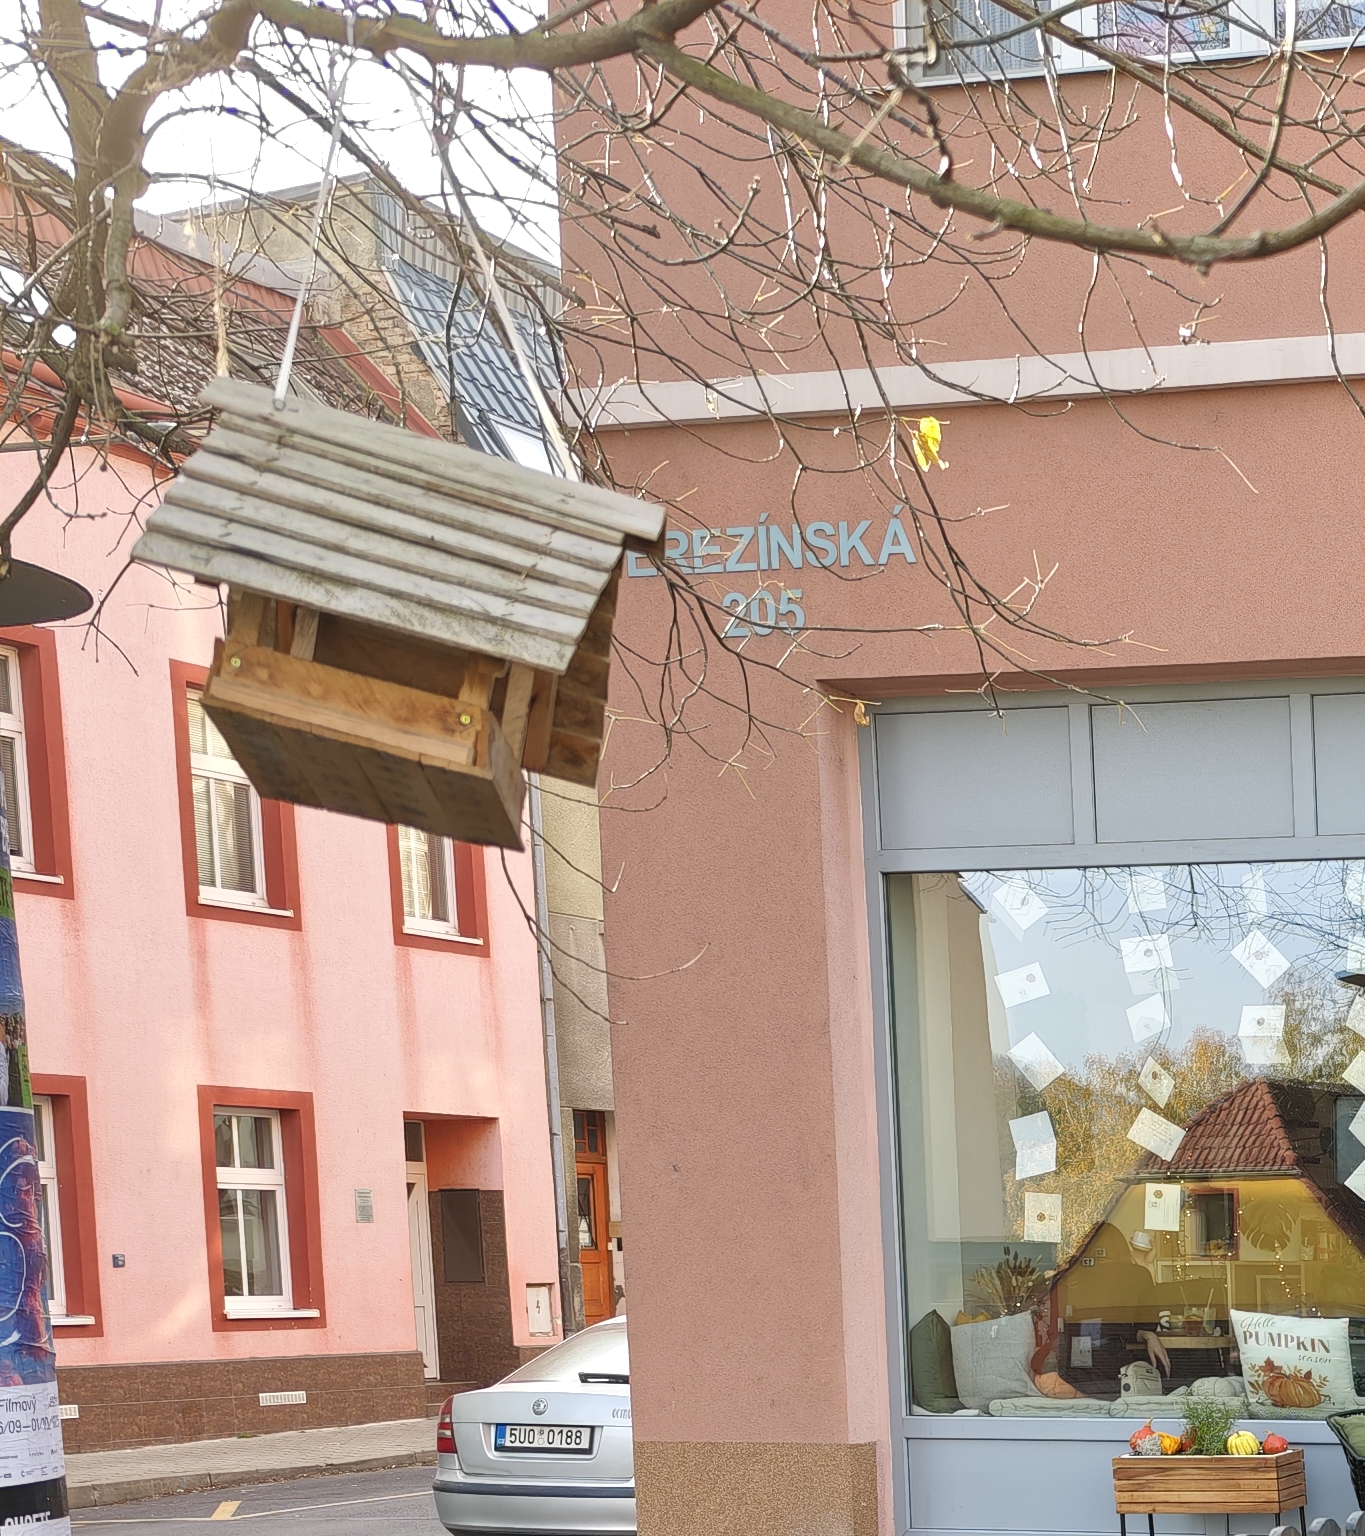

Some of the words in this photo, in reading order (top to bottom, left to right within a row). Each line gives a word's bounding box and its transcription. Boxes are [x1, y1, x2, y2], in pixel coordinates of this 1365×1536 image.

[722, 589, 806, 637] 205
[1240, 1316, 1277, 1331] Hello
[1242, 1330, 1331, 1354] PUMPKIN
[1298, 1354, 1332, 1364] season
[509, 1428, 536, 1444] 5U0
[547, 1429, 582, 1446] 0188
